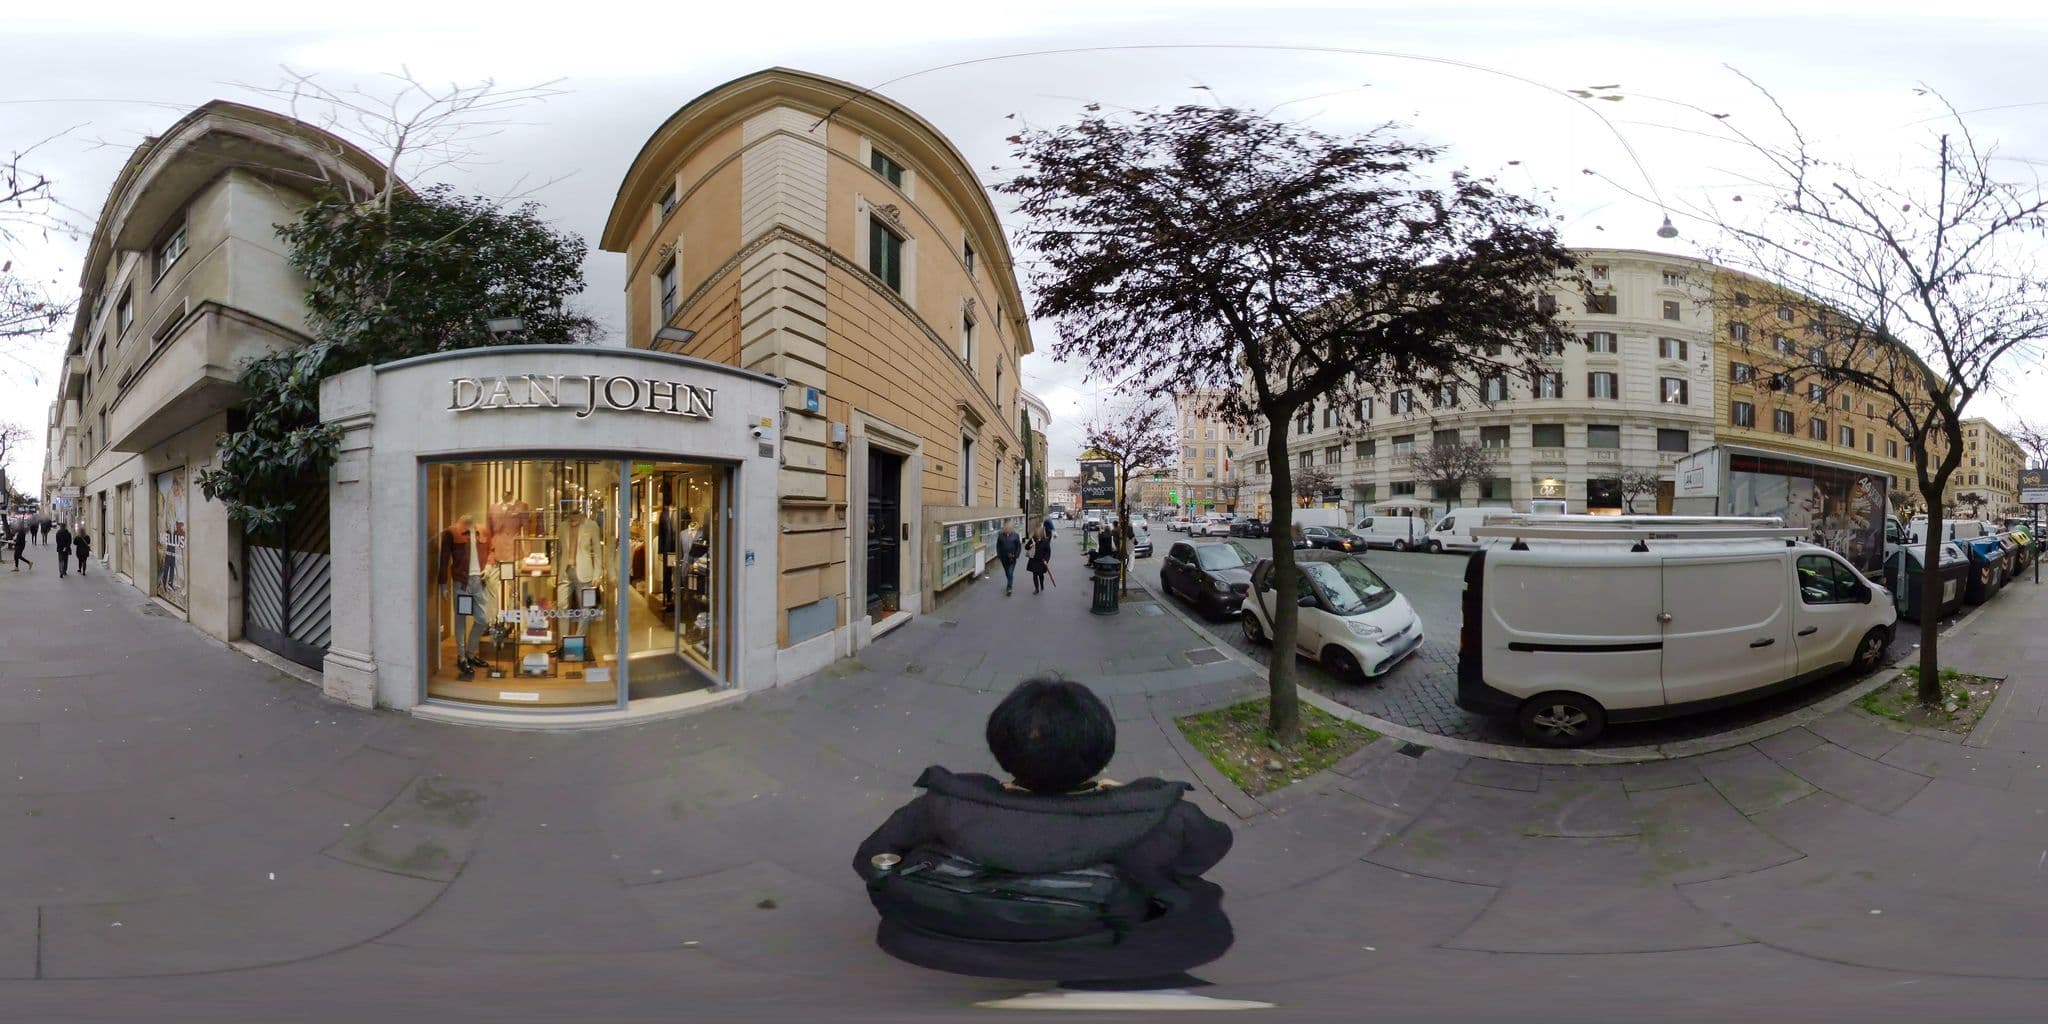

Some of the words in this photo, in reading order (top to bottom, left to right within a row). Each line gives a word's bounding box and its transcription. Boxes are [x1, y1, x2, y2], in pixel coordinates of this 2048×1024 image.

[447, 373, 565, 412] DAN
[576, 374, 718, 420] JOHN
[498, 609, 541, 623] NEW
[542, 608, 604, 619] COLLECTION
